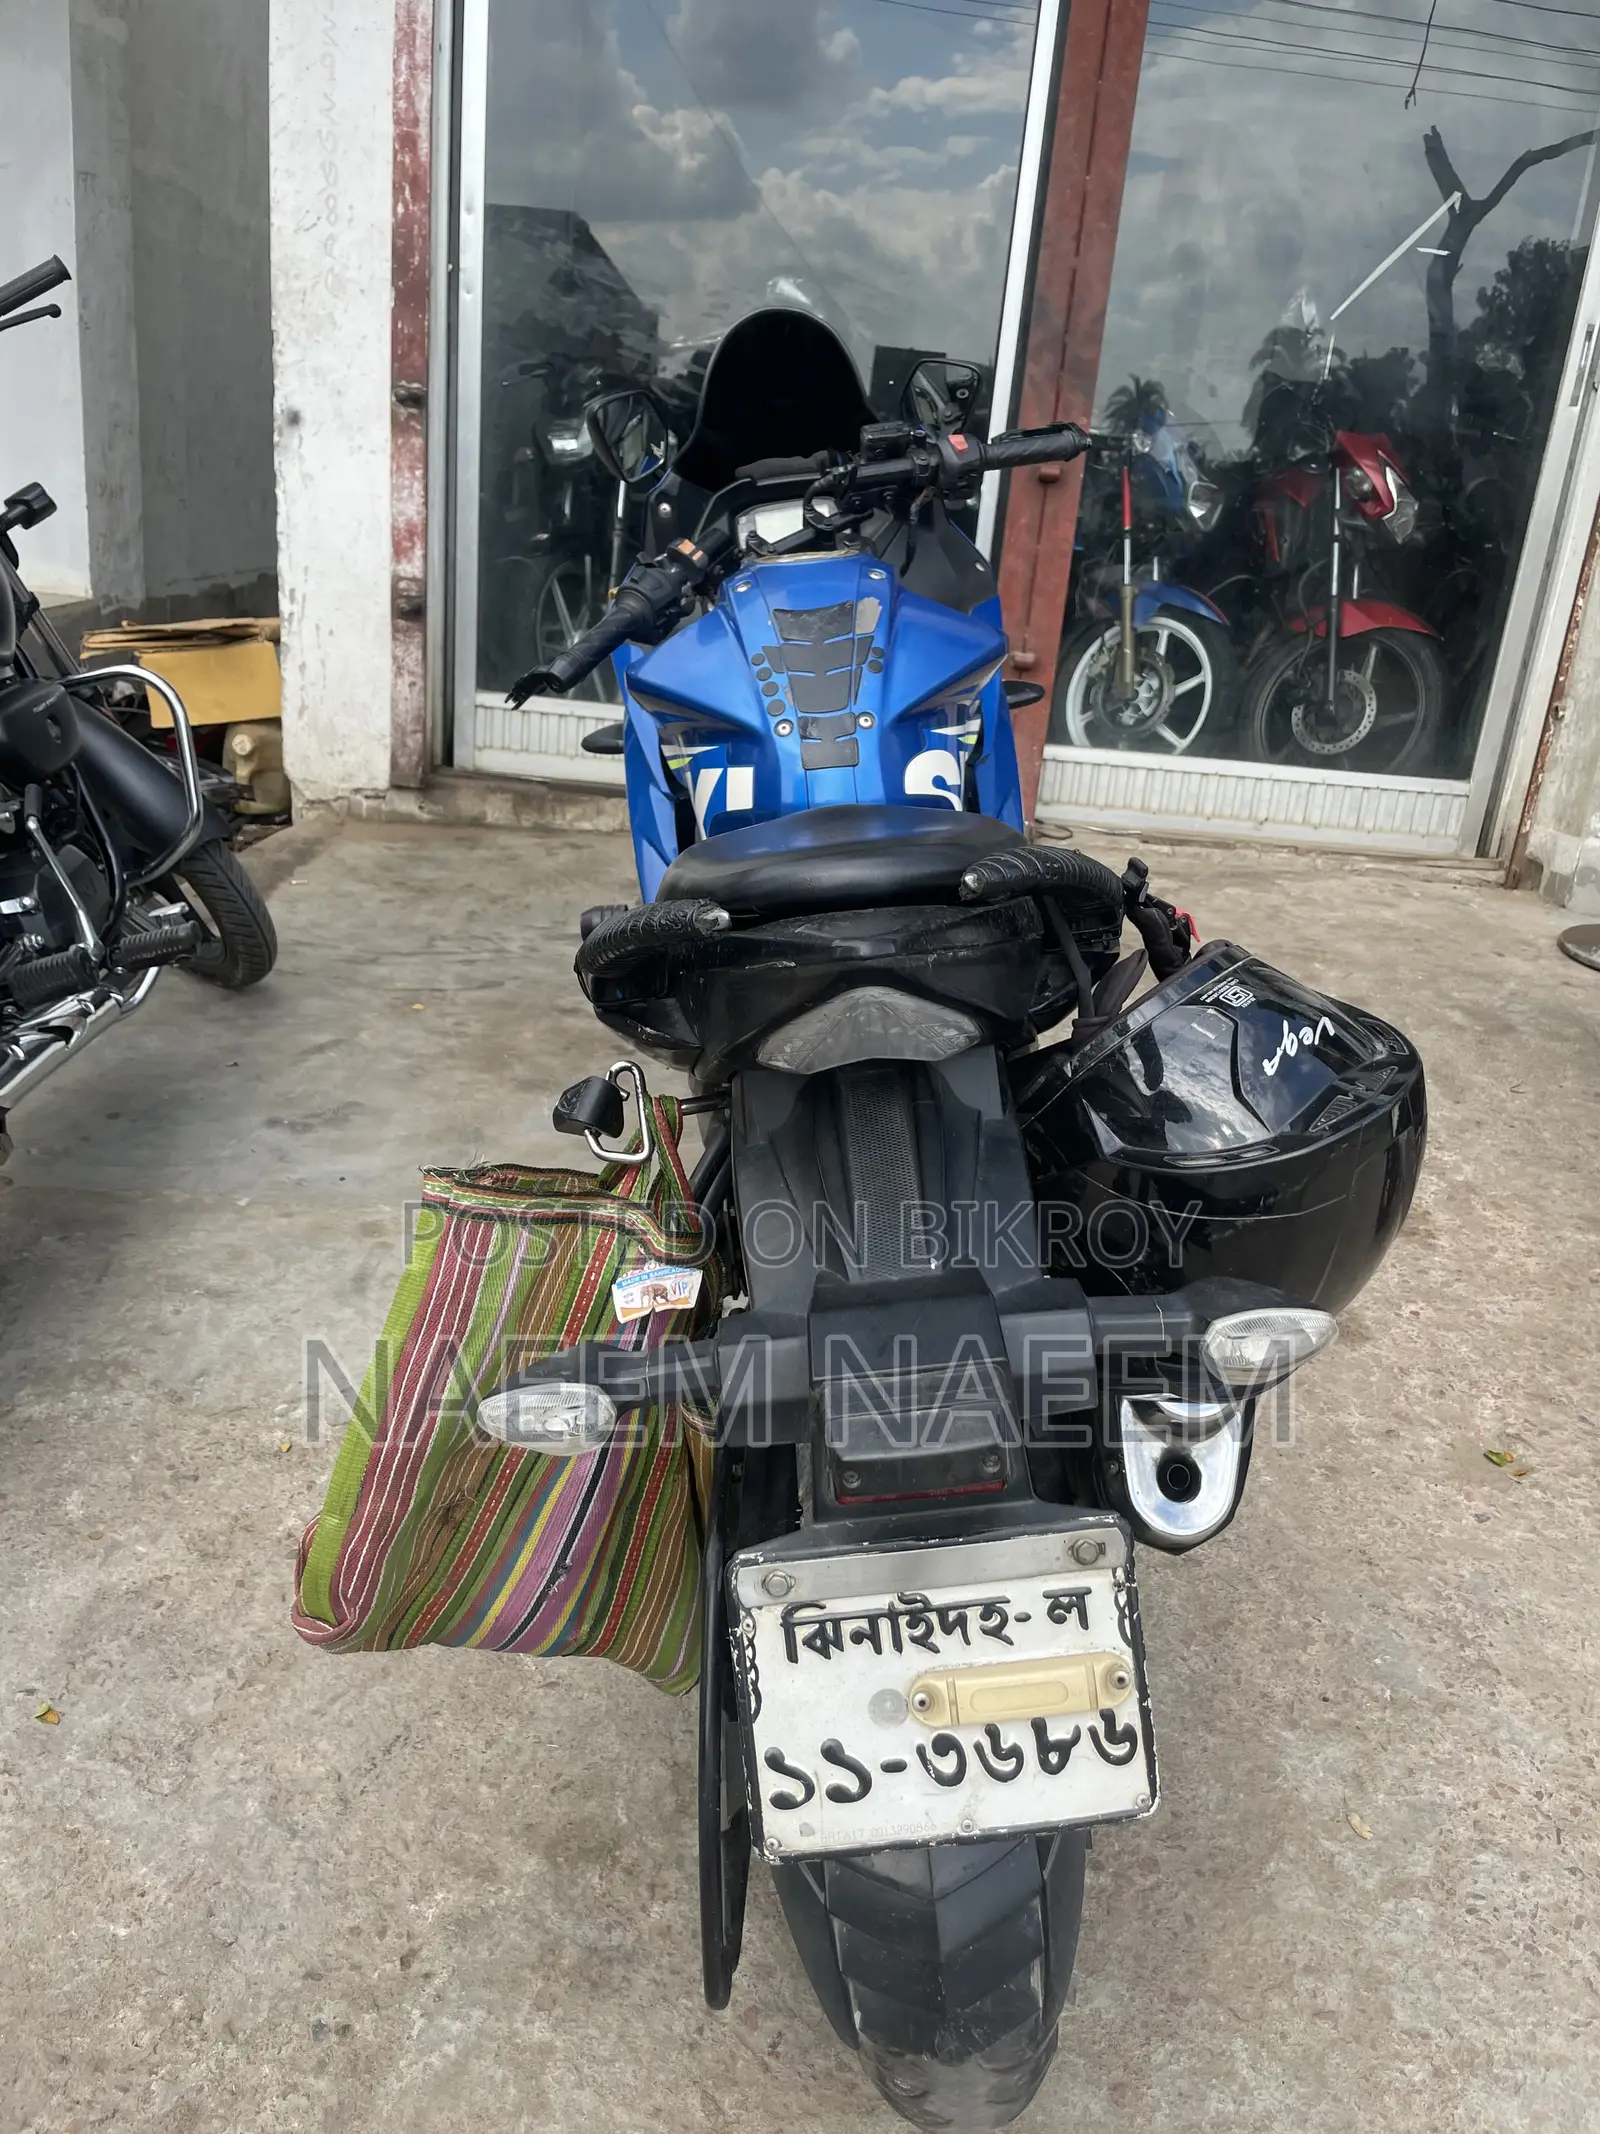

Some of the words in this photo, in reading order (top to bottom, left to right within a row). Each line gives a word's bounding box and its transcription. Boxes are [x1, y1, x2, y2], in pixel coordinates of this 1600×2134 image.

[1262, 1016, 1336, 1077] Vega
[621, 1275, 640, 1287] MADE
[670, 1280, 688, 1297] VIP
[763, 1709, 1138, 1811] ১১-৩৬৮৬
